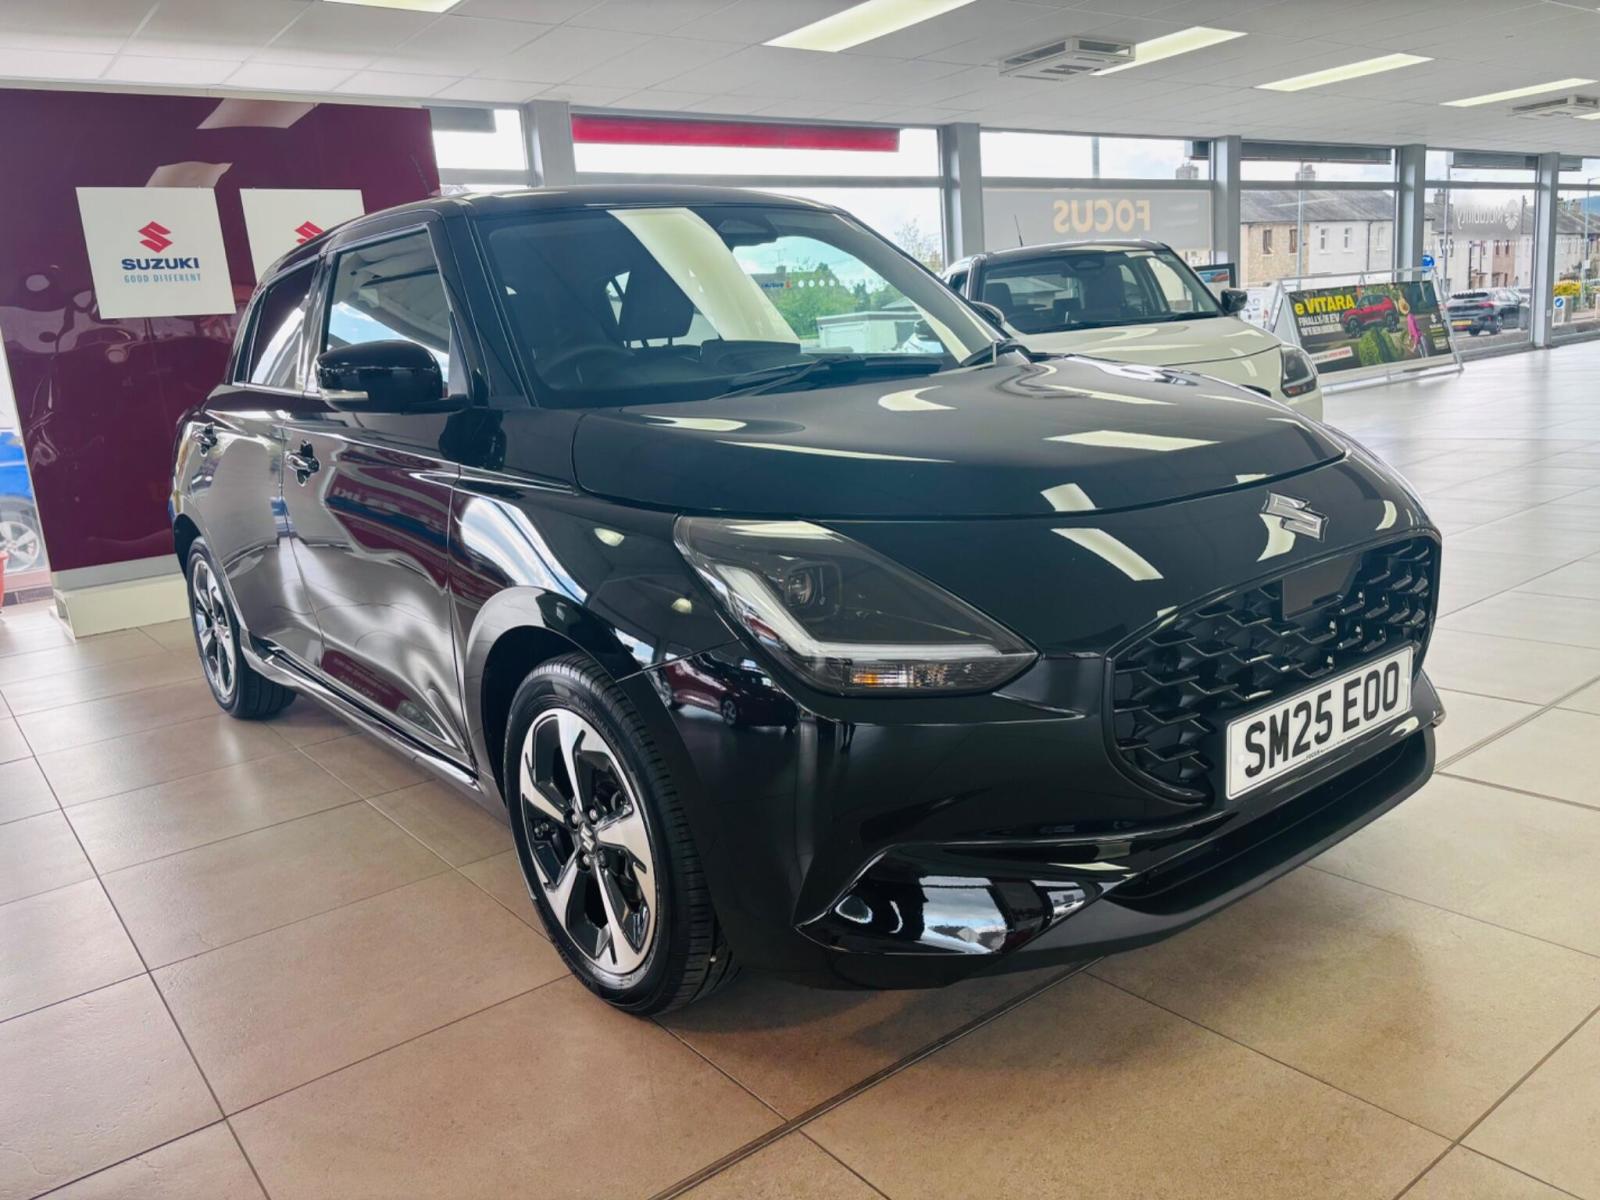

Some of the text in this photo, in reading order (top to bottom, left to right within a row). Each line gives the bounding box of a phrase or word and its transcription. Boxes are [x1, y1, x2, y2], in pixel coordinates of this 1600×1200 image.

[121, 257, 200, 270] SUZUKI
[124, 274, 149, 283] GOOD
[1294, 295, 1355, 315] e VITARA
[1244, 689, 1333, 778] SM25
